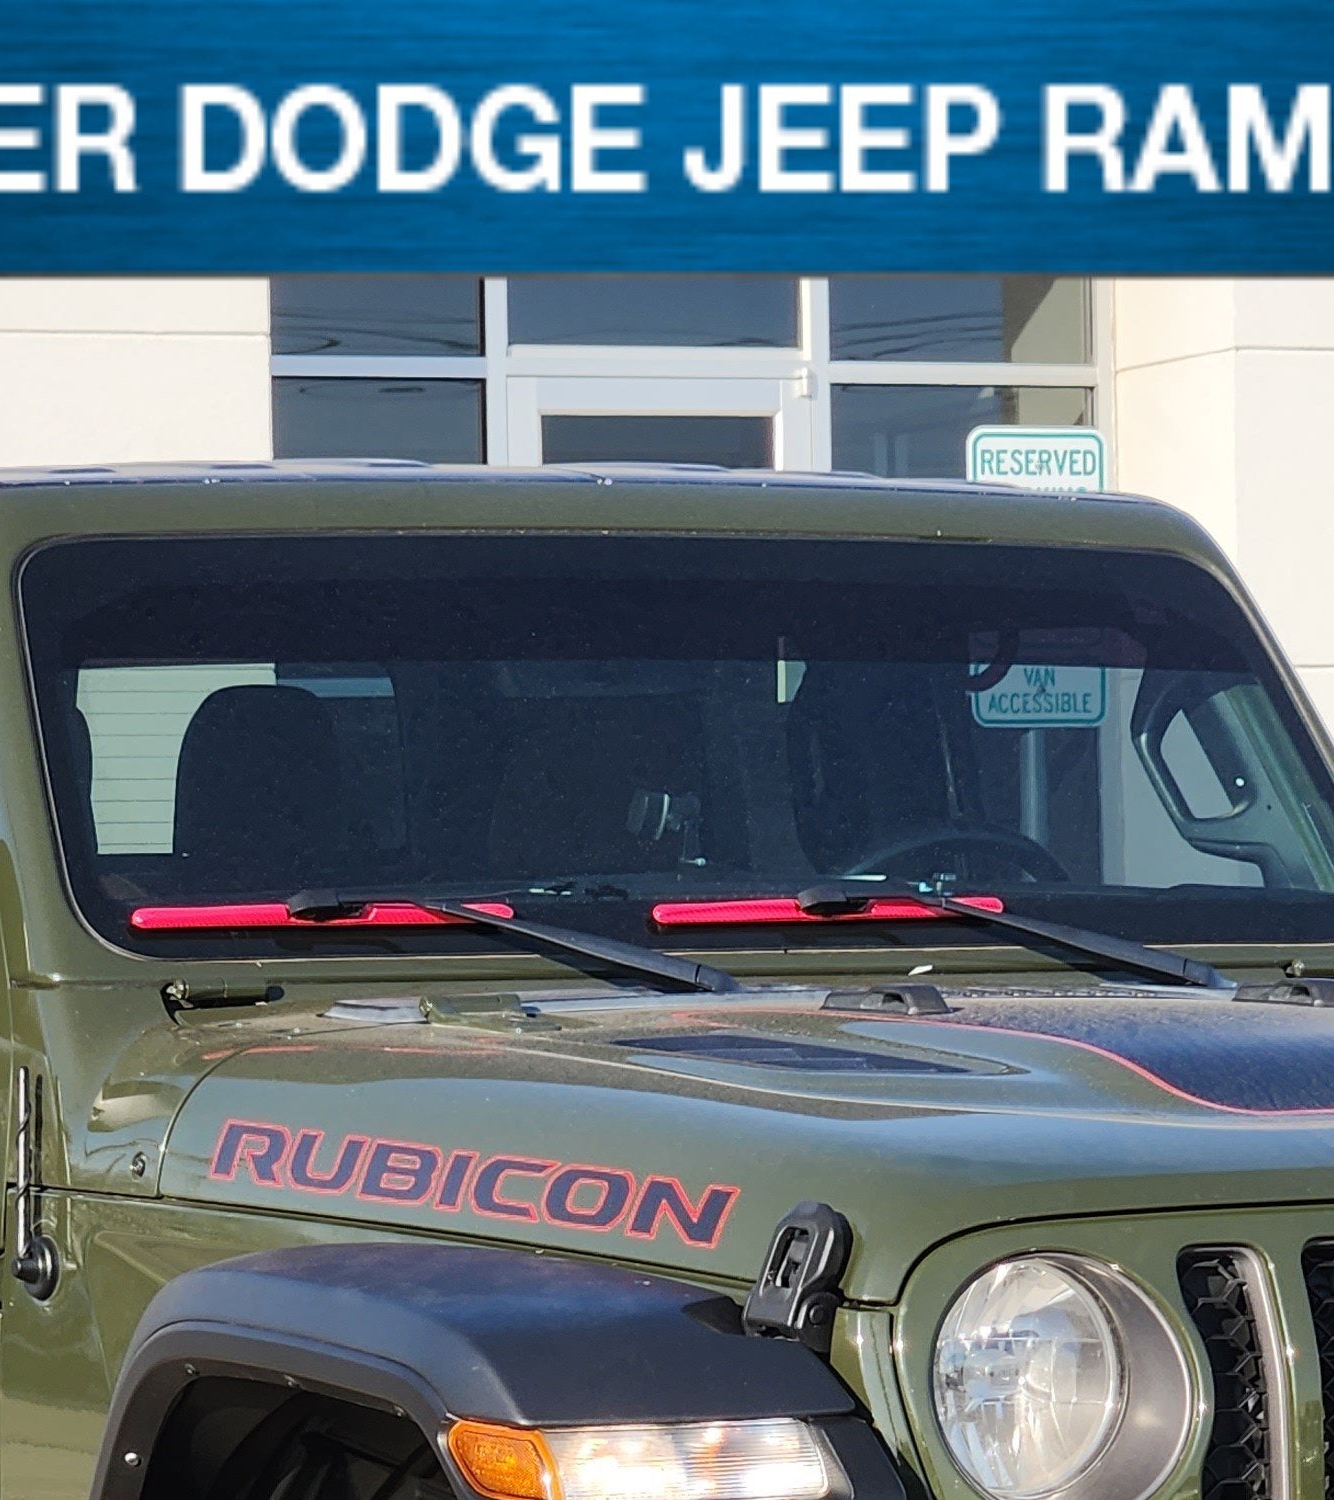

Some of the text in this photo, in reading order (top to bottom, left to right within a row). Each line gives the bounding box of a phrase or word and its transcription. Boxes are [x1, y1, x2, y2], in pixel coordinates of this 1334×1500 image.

[979, 448, 1097, 477] RESERVED
[1023, 667, 1056, 688] VAN
[987, 692, 1093, 715] ACCESSIBLE
[209, 1117, 742, 1249] RUBICON
